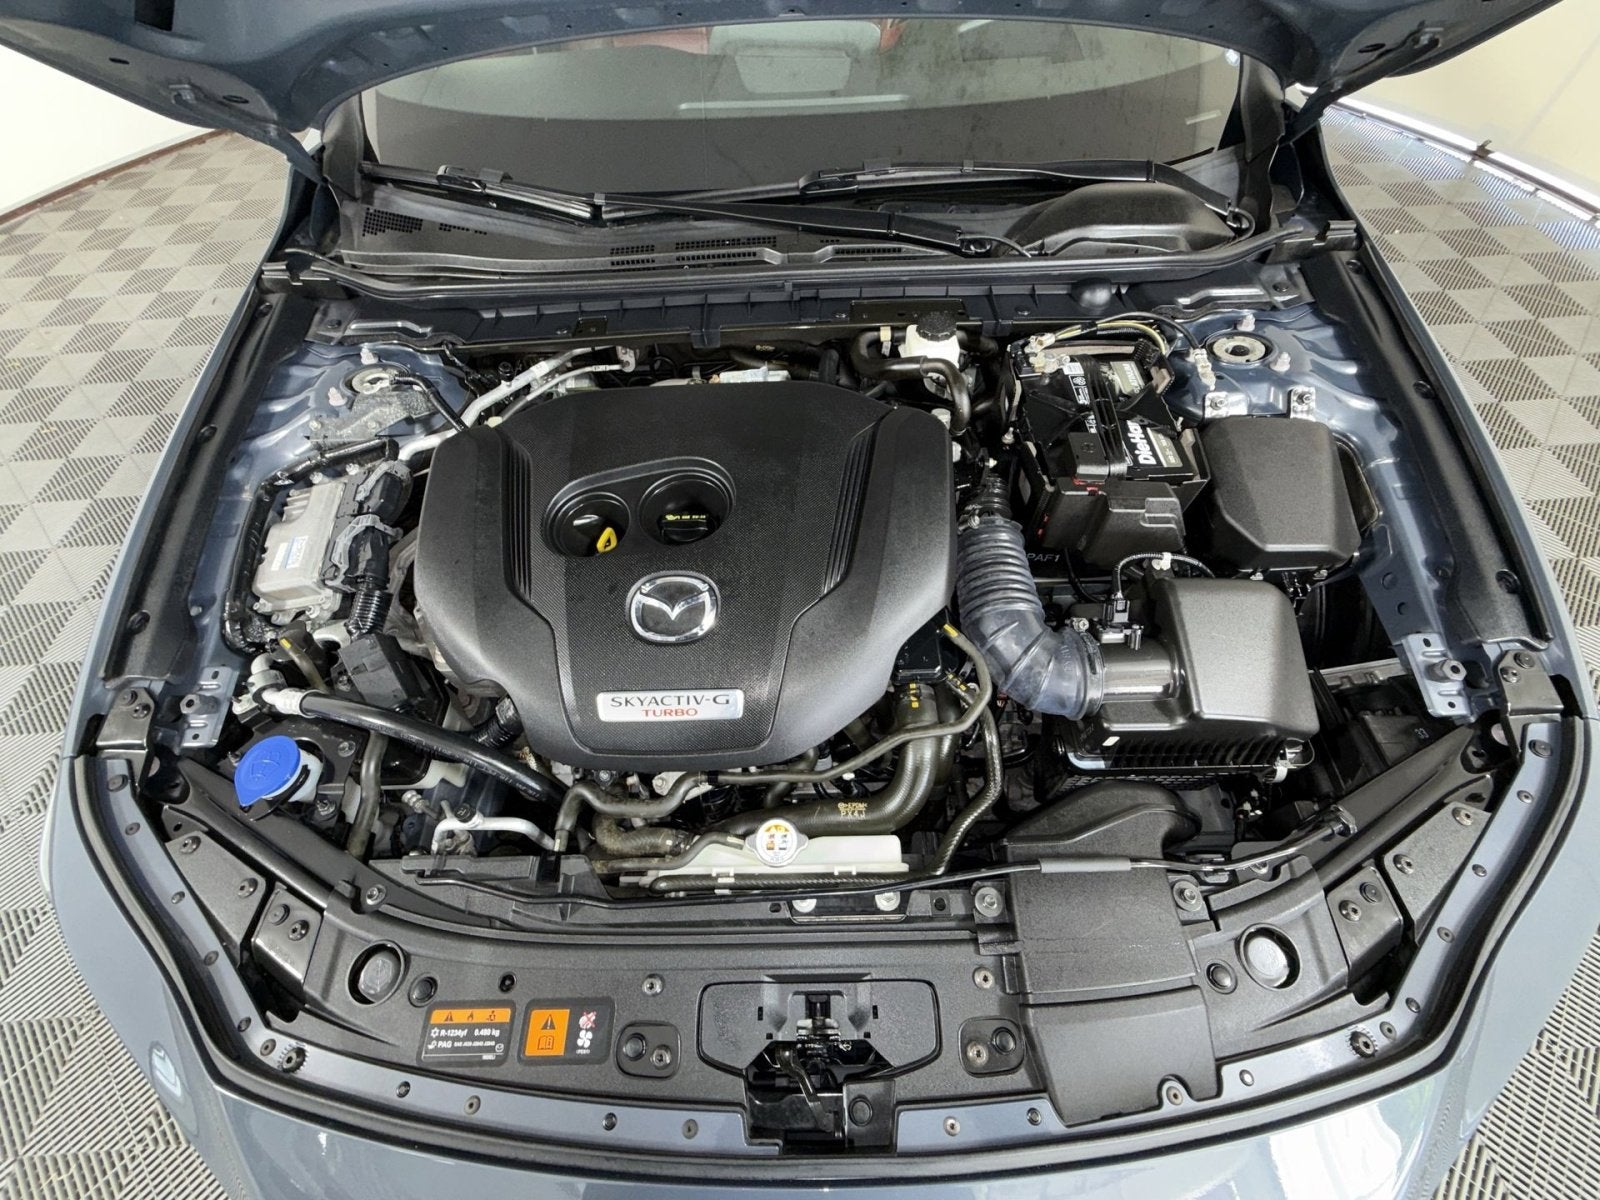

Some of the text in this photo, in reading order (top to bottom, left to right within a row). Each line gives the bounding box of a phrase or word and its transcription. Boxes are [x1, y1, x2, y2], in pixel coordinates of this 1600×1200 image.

[1126, 419, 1157, 465] DieHar
[610, 694, 730, 708] SKYACTIV-G
[642, 707, 698, 718] TURBO
[437, 1040, 453, 1049] PAG
